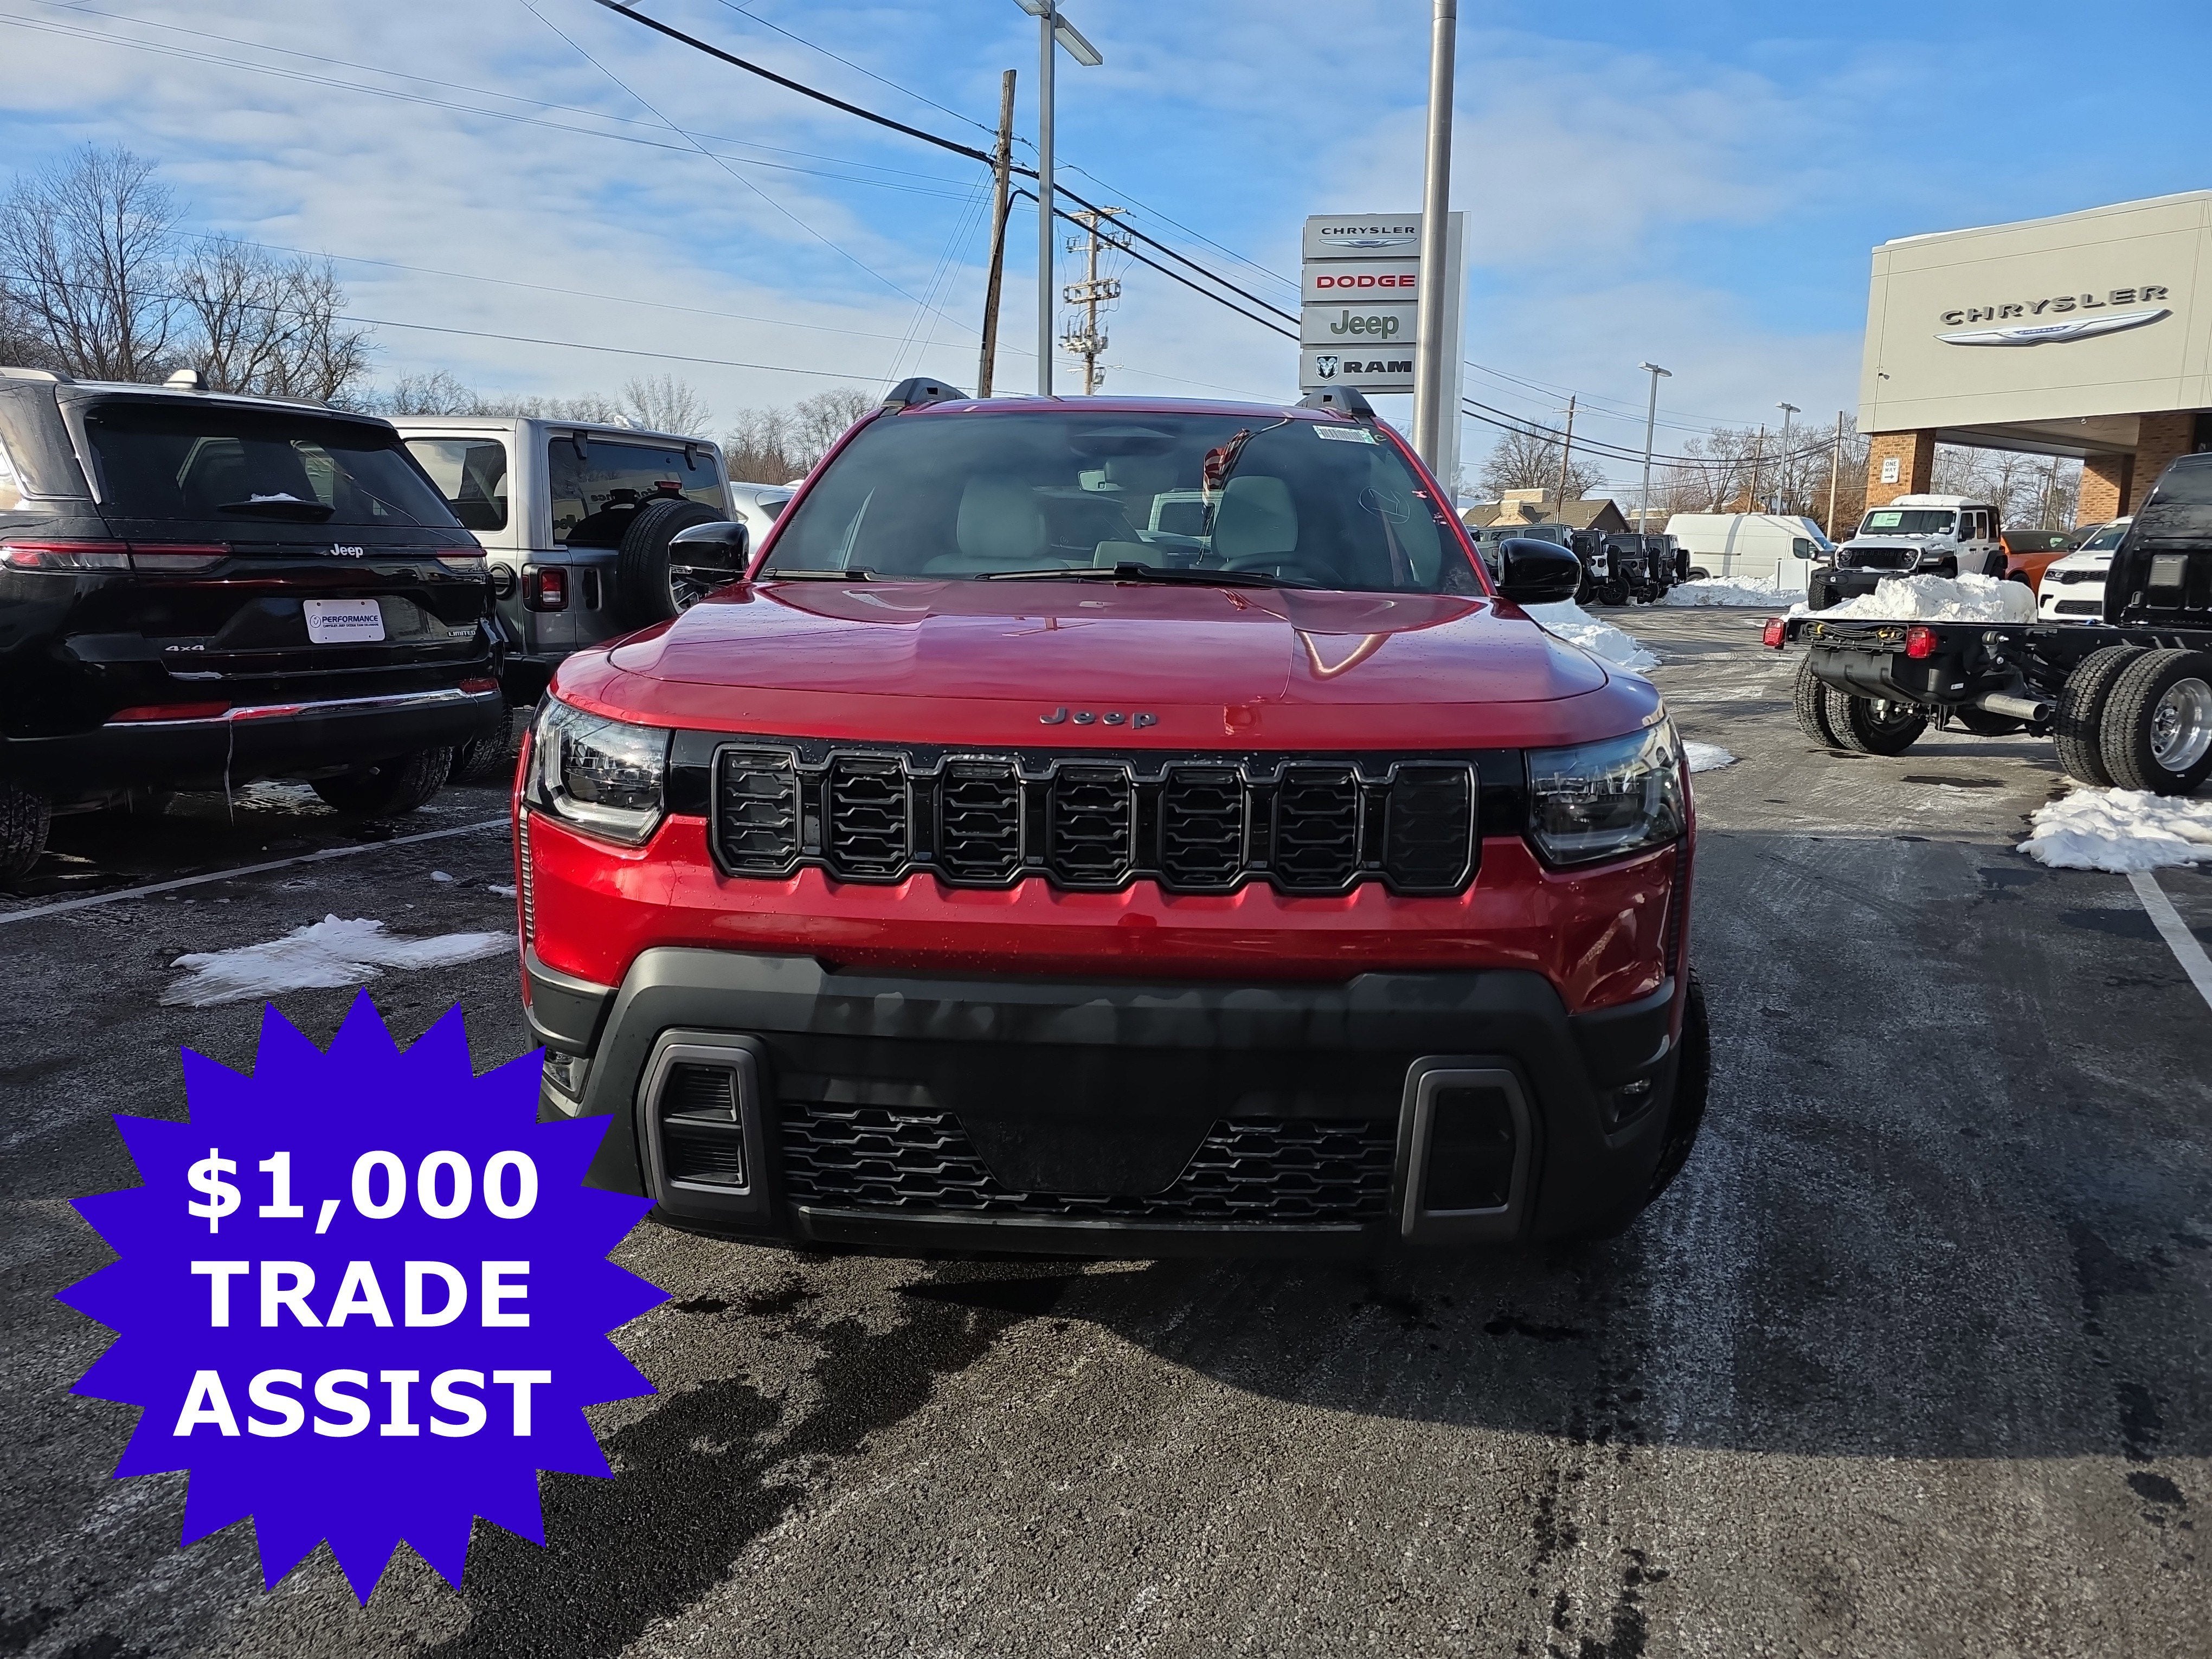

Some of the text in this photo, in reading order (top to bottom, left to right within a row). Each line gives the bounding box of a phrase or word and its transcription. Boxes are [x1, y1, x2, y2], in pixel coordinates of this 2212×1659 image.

[1321, 227, 1415, 235] CHRYSLER
[1317, 275, 1416, 288] DODGE
[1939, 285, 2168, 324] CHRYSLER
[1330, 310, 1399, 339] Jeep
[1343, 361, 1412, 374] RAM
[330, 543, 364, 558] Jeep
[322, 615, 378, 623] PERFORMANCE
[1039, 708, 1156, 729] Jeep
